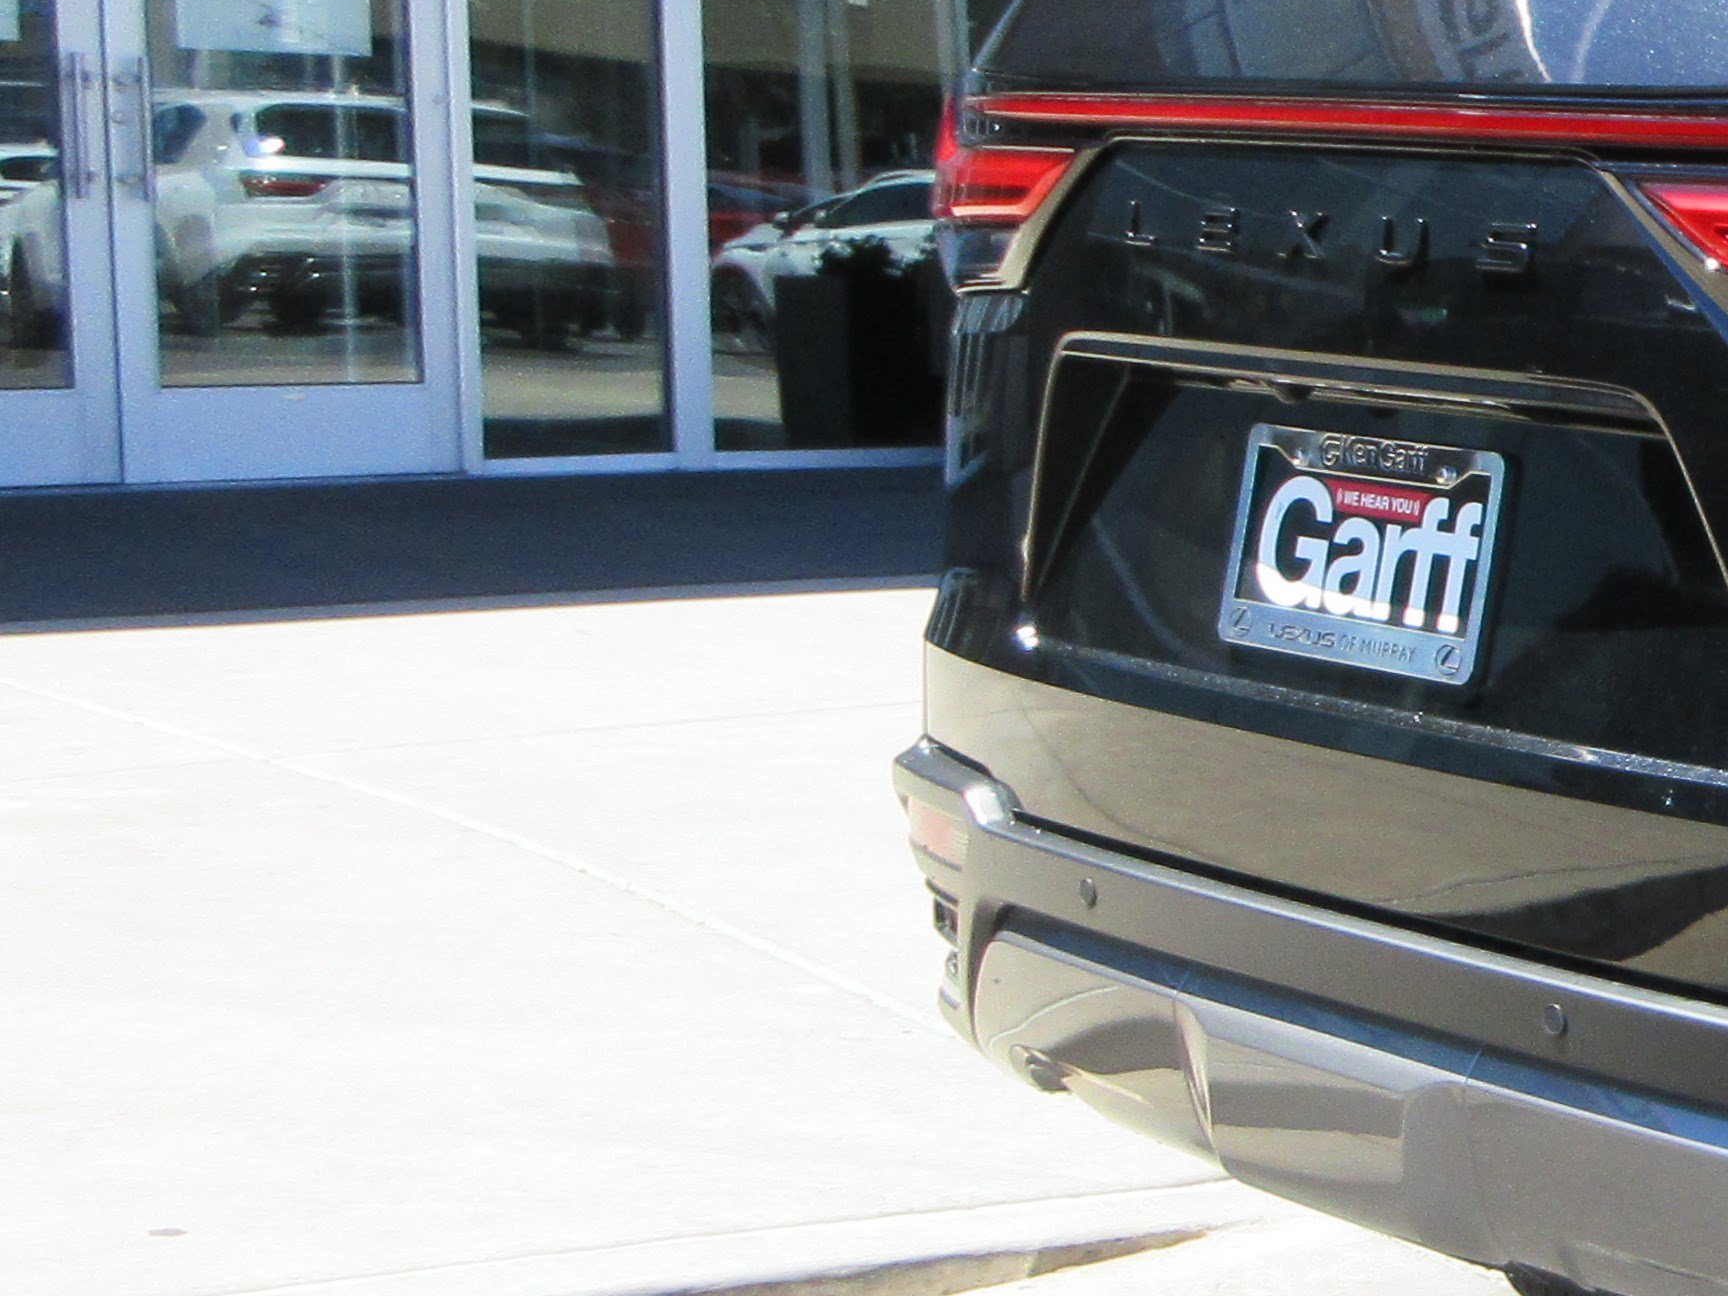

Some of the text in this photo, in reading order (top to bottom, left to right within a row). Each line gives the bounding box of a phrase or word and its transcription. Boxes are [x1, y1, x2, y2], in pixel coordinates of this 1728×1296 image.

[1123, 200, 1538, 273] LEXUS
[1343, 490, 1413, 516] WE HEAR YOU
[1255, 475, 1483, 634] Garff
[1268, 622, 1417, 663] LEXUS OF MURRAY
